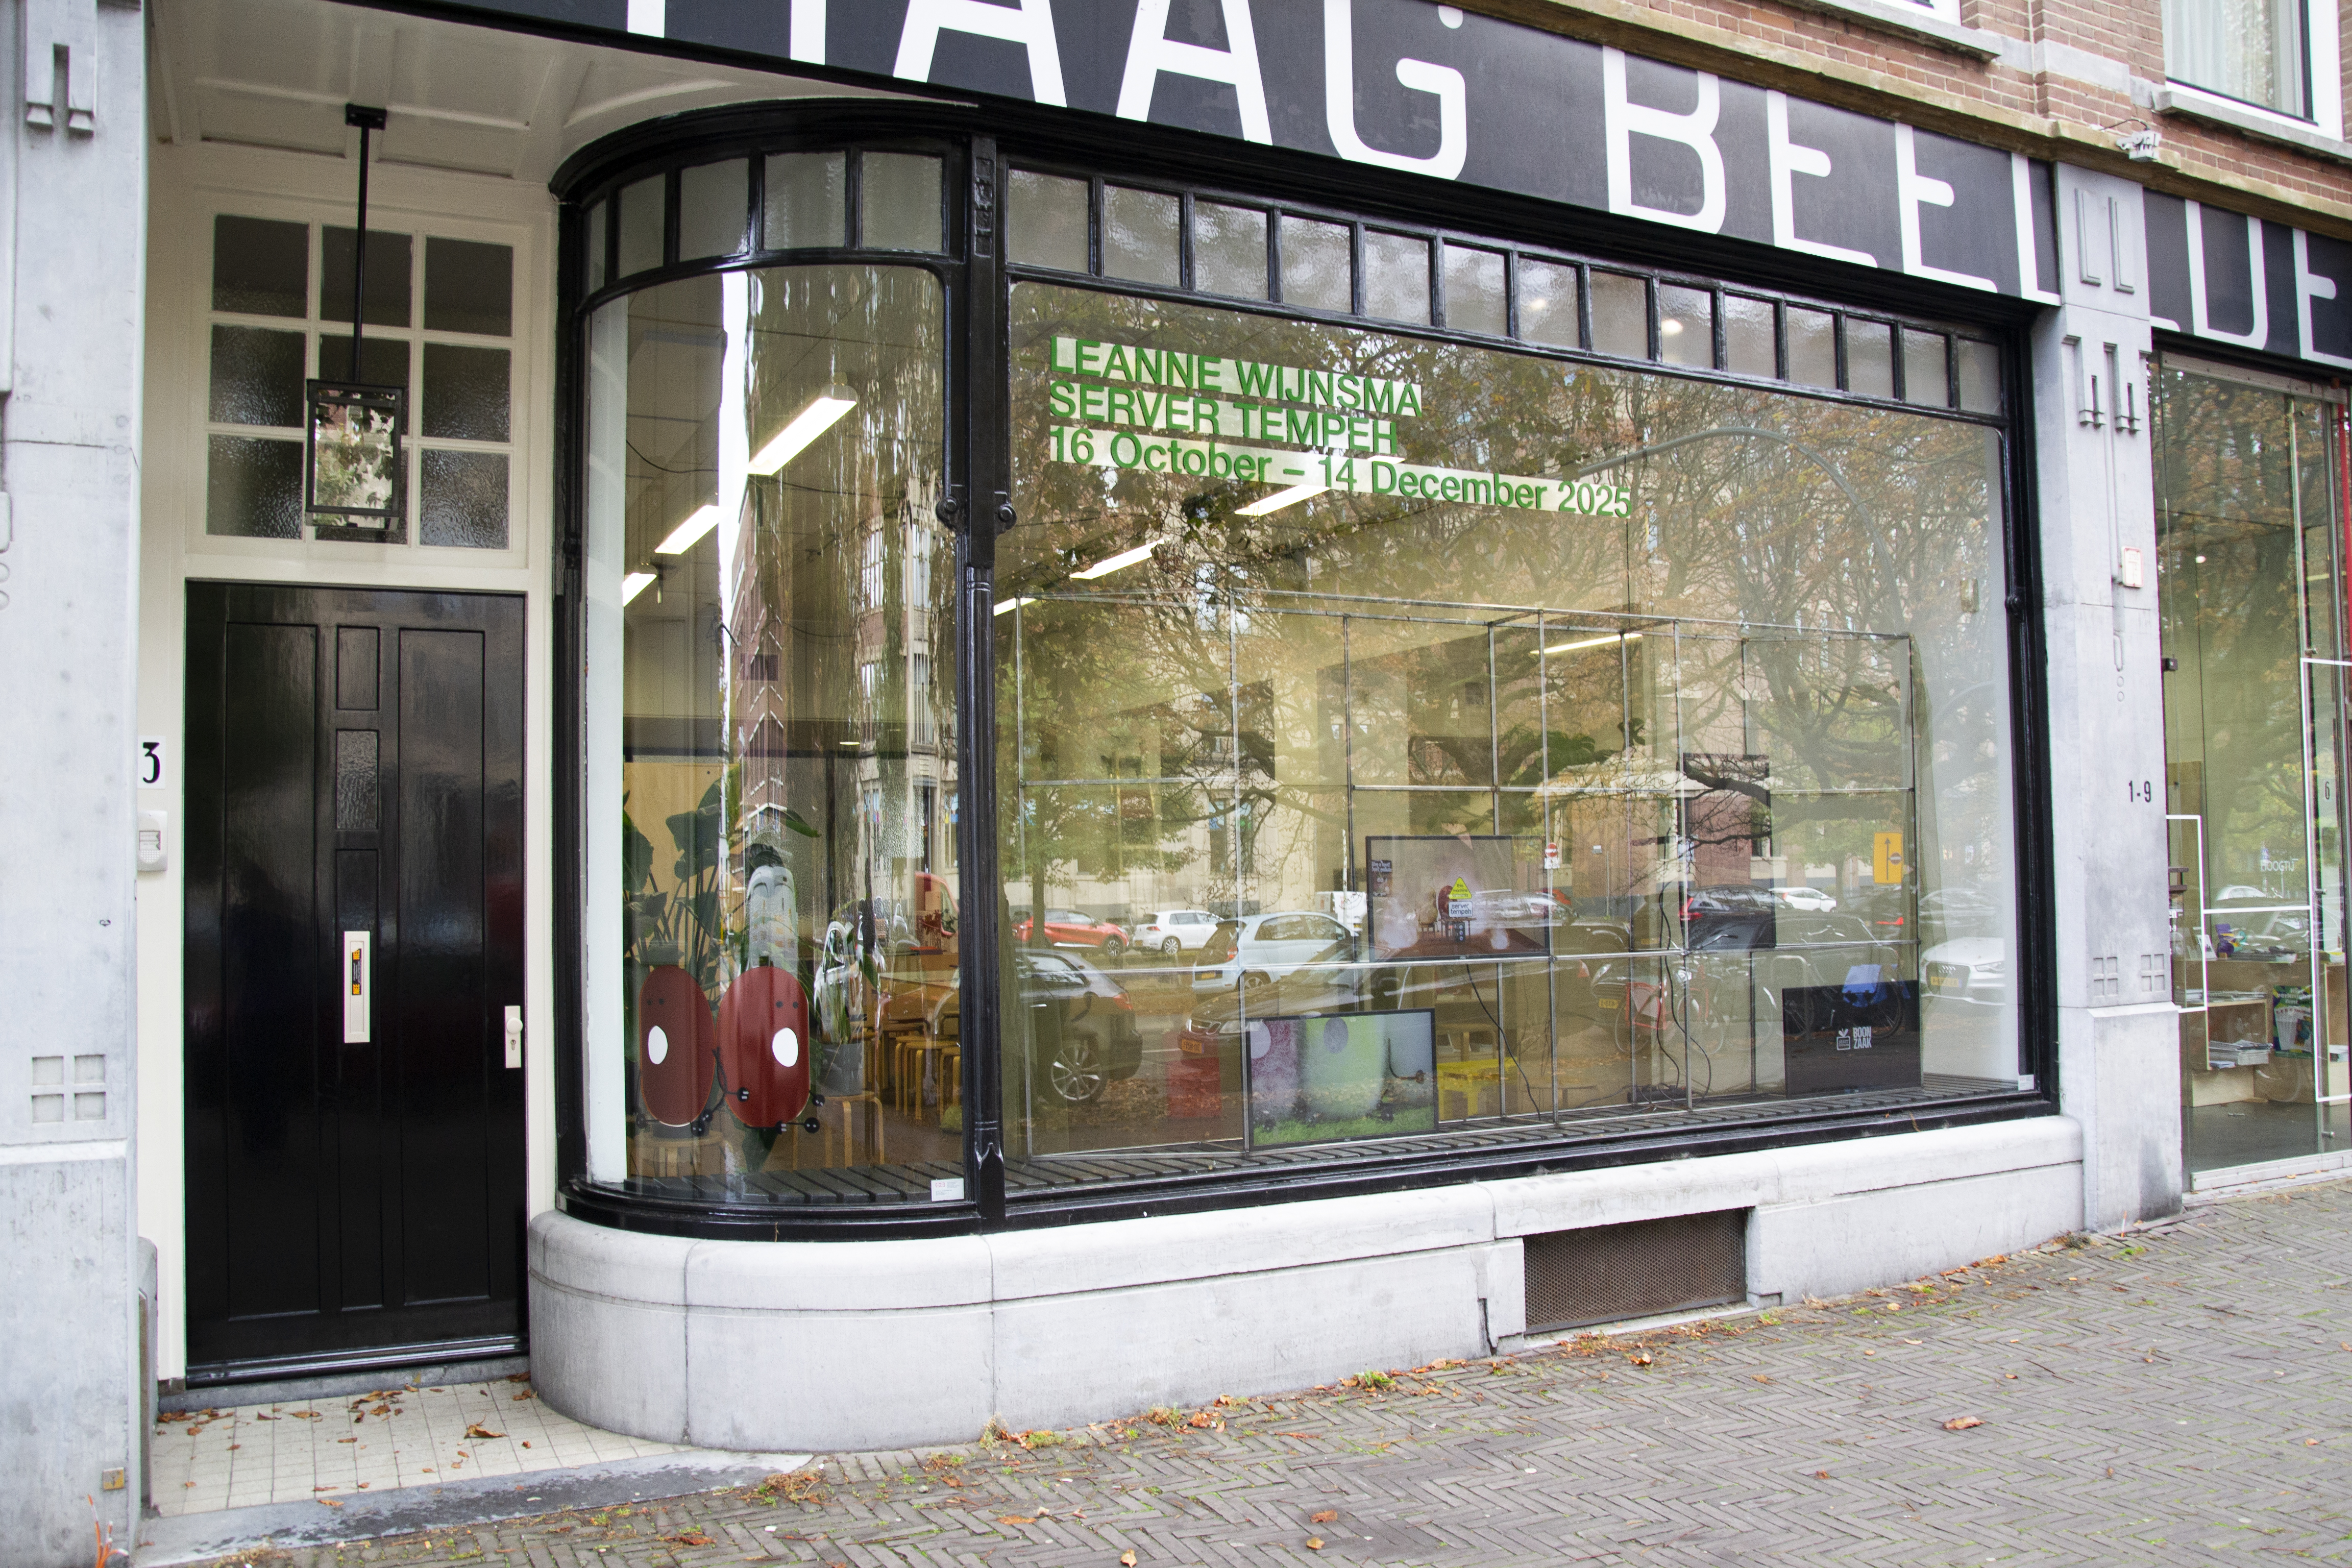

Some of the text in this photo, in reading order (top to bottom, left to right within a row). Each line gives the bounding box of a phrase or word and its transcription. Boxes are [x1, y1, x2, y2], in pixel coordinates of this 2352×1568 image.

[1050, 335, 1423, 418] LEANNE WIJNSMA
[1049, 380, 1398, 454] SERVER TEMPEH
[1050, 426, 1094, 464] 16
[1110, 432, 1272, 482] October
[1318, 455, 1358, 491] 14
[1371, 460, 1548, 509] December
[1558, 480, 1632, 519] 2025
[142, 741, 161, 783] 3
[2128, 780, 2151, 803] 1-9
[1450, 908, 1472, 916] tempeh
[1853, 1026, 1872, 1038] BOON
[1853, 1037, 1872, 1049] ZAAK
